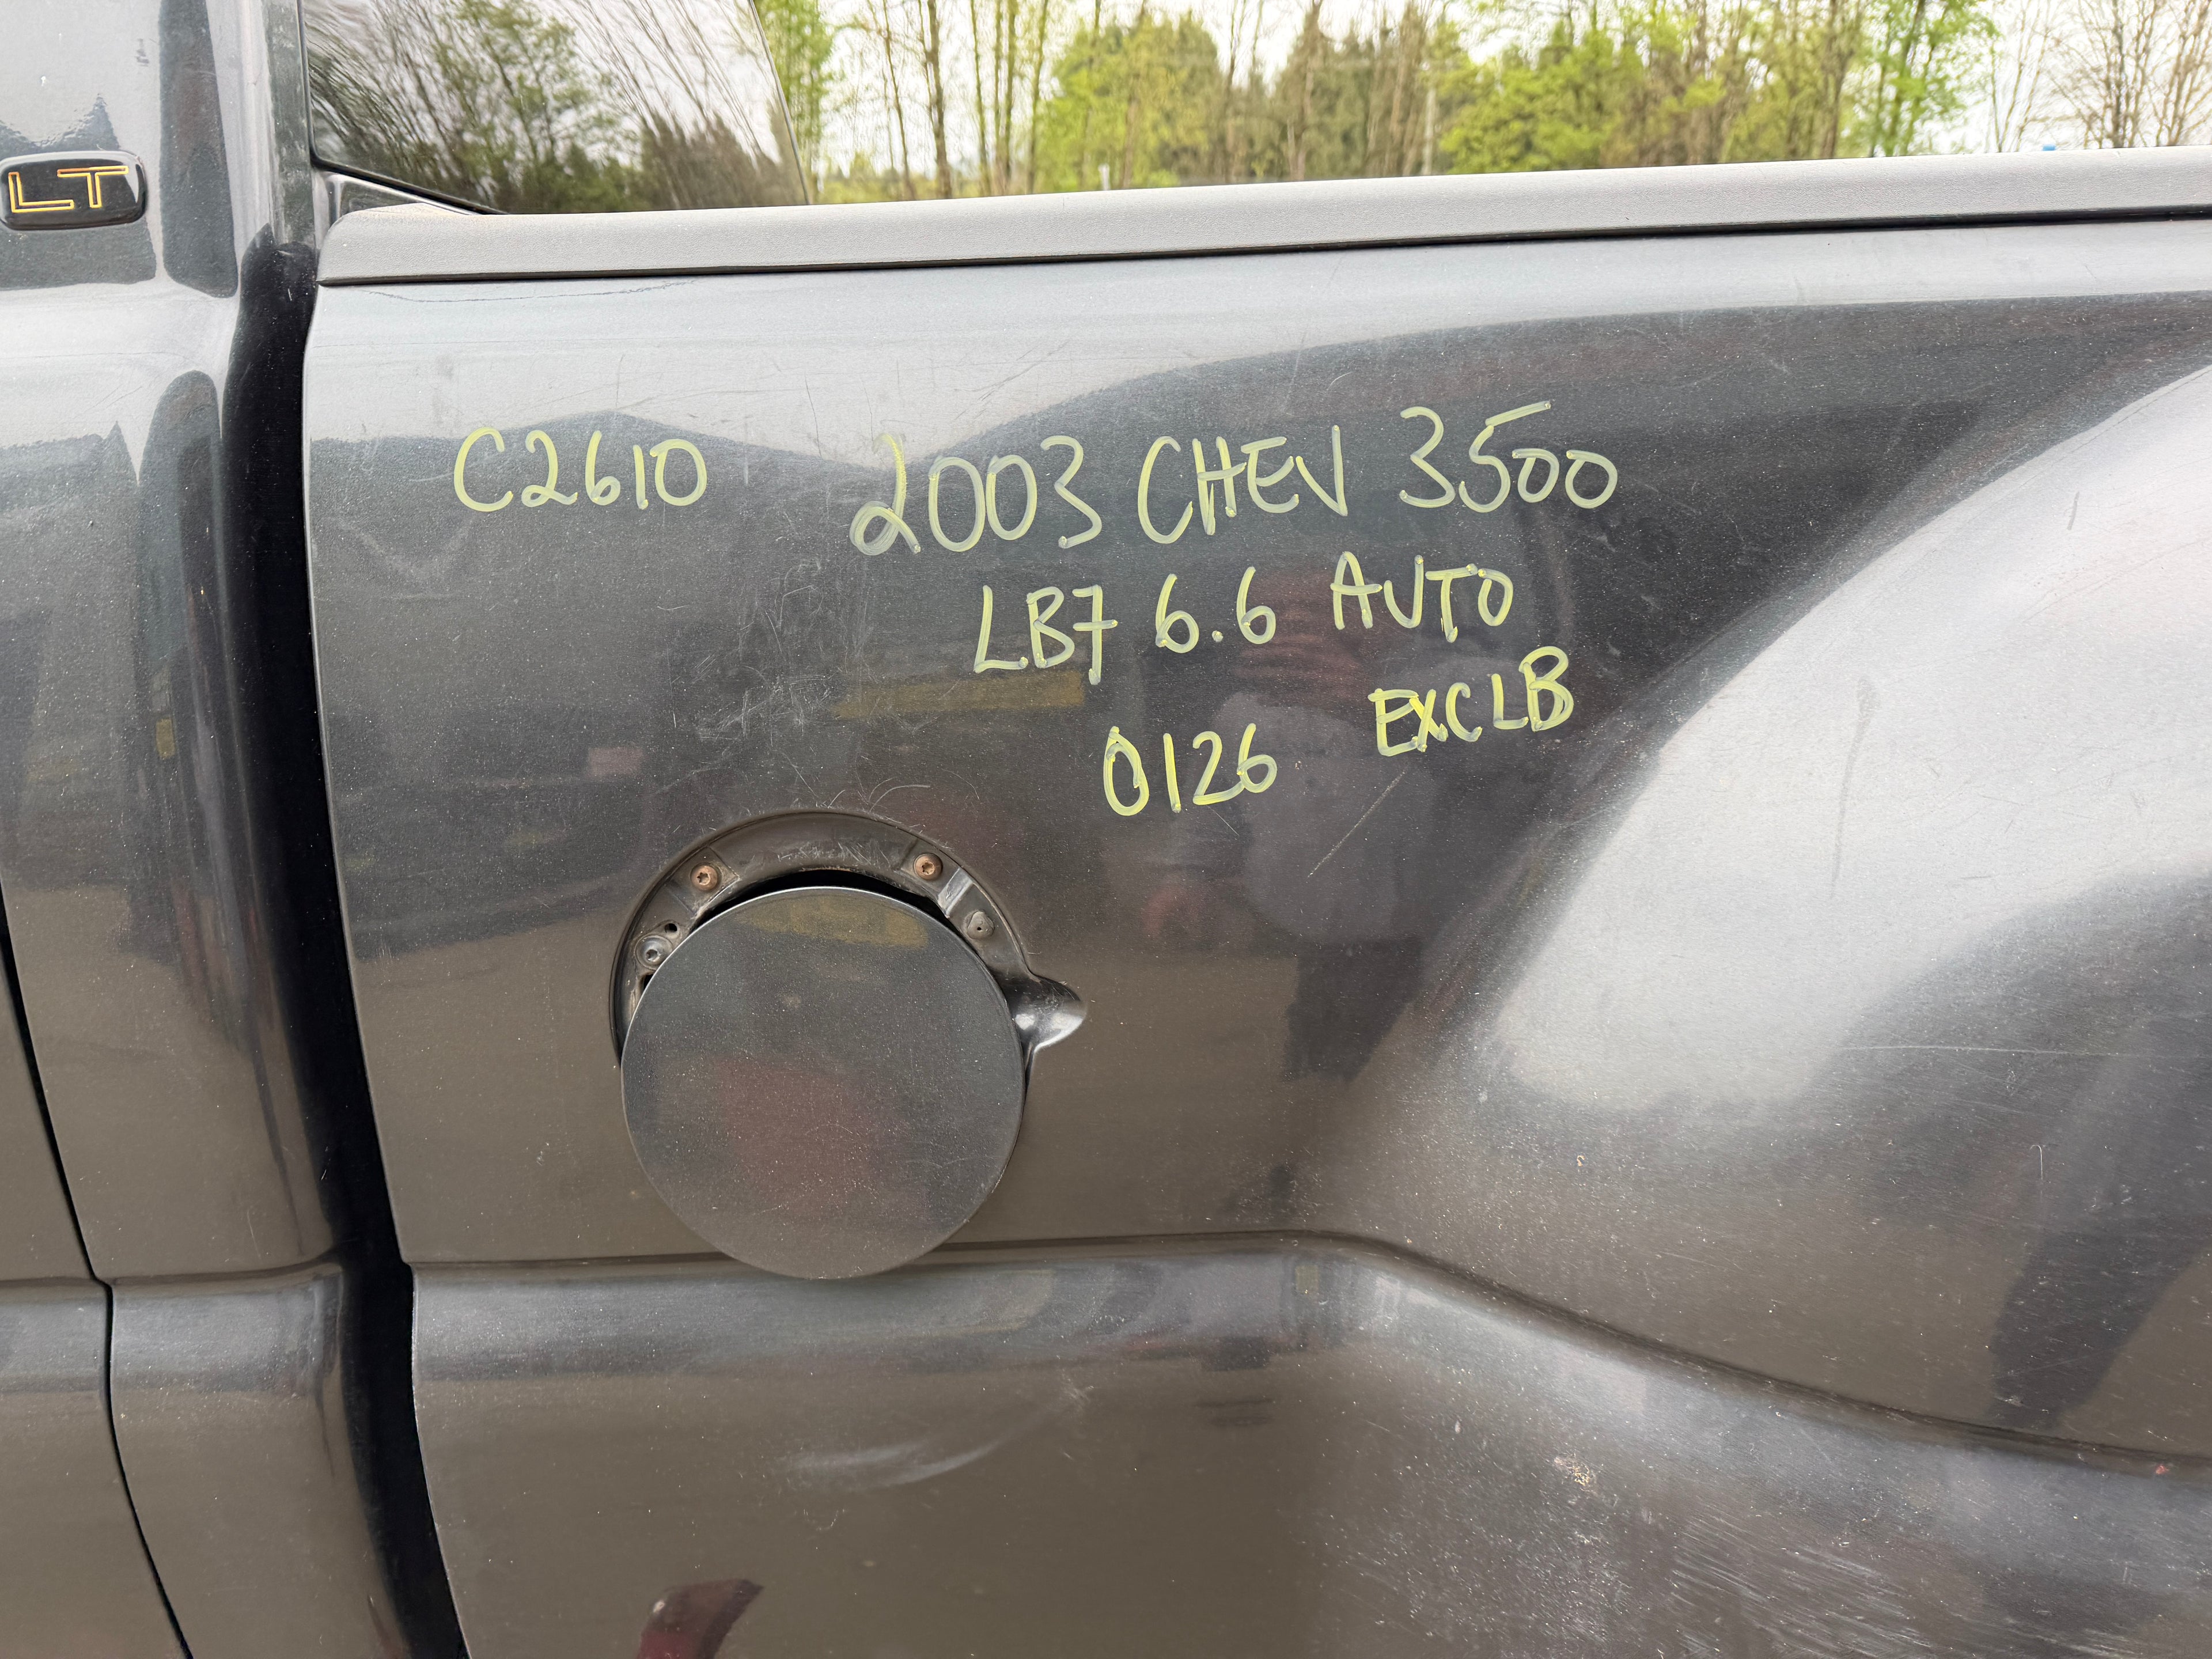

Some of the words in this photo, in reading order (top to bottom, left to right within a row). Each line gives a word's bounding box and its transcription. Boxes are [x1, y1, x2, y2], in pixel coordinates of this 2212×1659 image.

[8, 165, 128, 213] LT
[453, 426, 707, 512] C2610
[850, 432, 1102, 556] 2003
[1138, 424, 1348, 544] CHEV
[1399, 400, 1619, 513] 3500
[974, 584, 1118, 685] LB7
[1155, 566, 1277, 654] 6.6
[1330, 551, 1514, 643] AUTO
[1103, 722, 1278, 816] 0126
